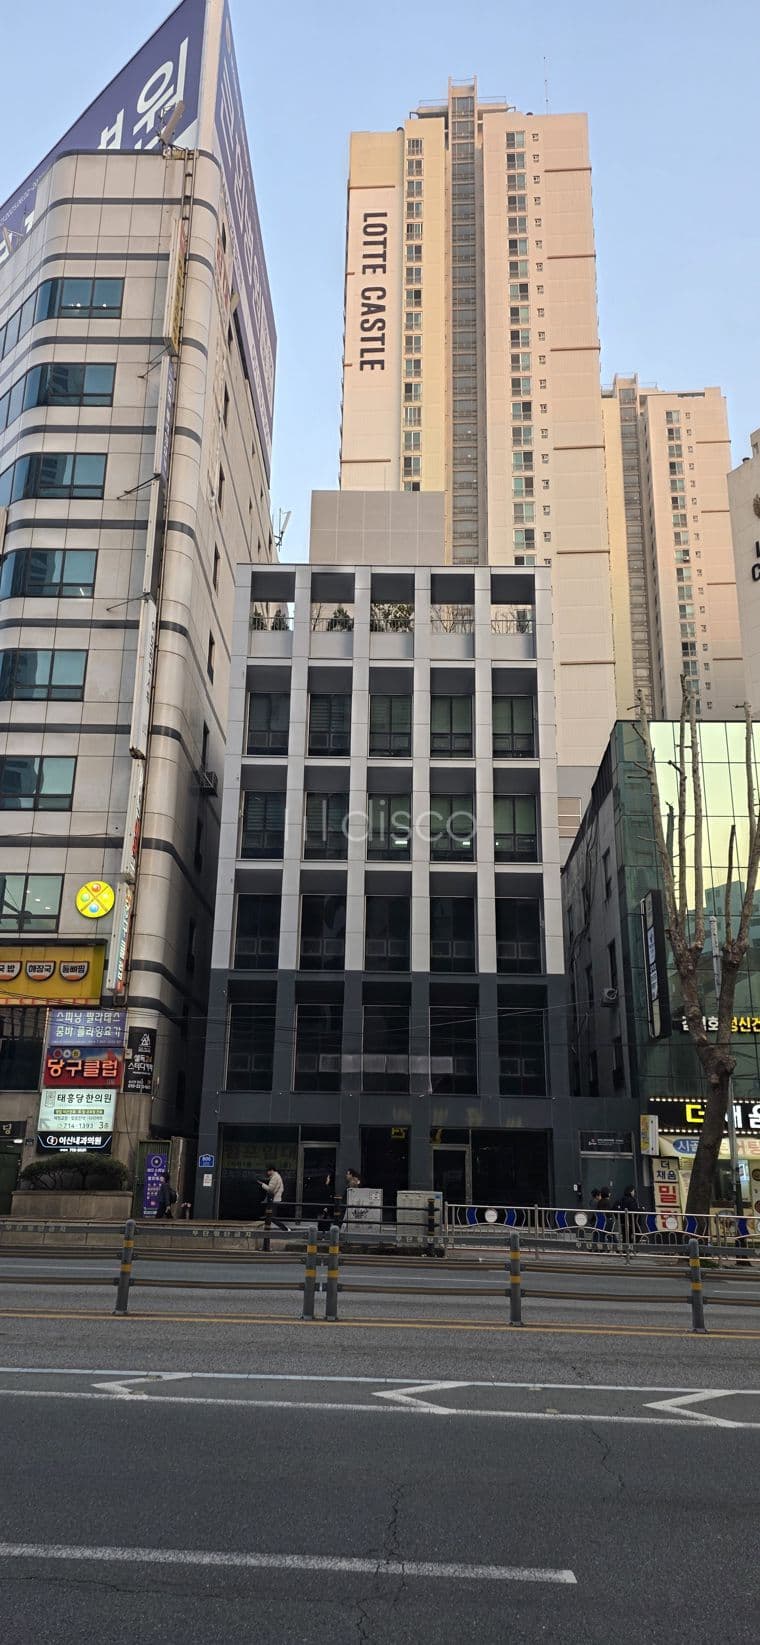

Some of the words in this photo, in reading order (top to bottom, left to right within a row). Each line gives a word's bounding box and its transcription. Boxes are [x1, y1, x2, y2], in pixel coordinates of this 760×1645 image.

[361, 211, 388, 275] LOTTE
[359, 286, 387, 371] CASTLE
[56, 1012, 82, 1023] 스피닝
[86, 1012, 121, 1023] 필라테스
[56, 1026, 73, 1037] 줌바
[47, 1059, 118, 1077] 당구클럽
[59, 1136, 102, 1146] 이신내과의원
[661, 1160, 670, 1170] 더
